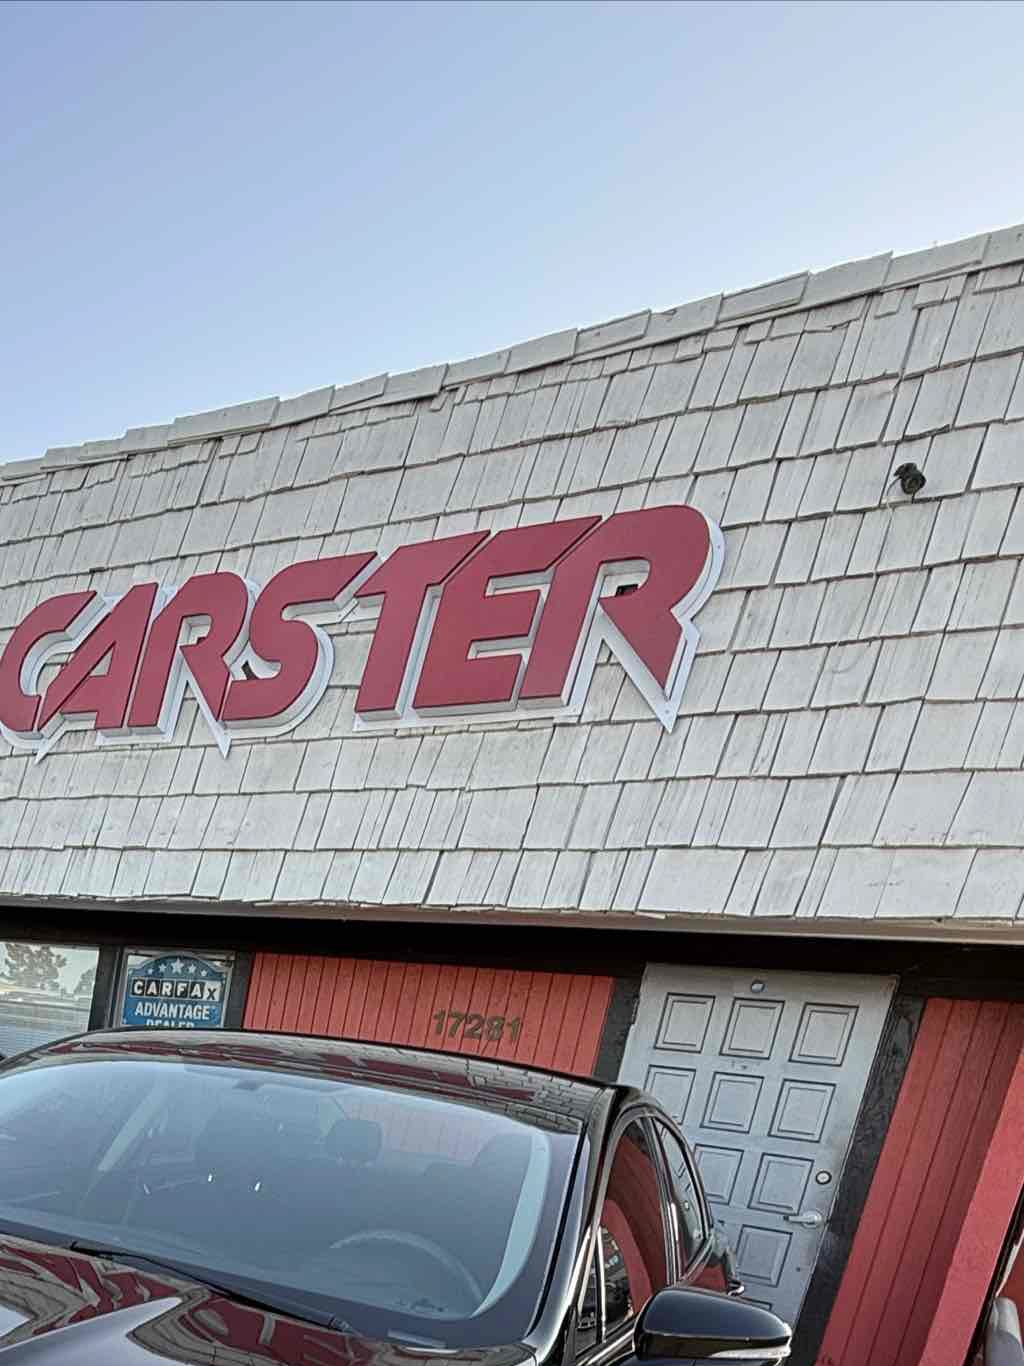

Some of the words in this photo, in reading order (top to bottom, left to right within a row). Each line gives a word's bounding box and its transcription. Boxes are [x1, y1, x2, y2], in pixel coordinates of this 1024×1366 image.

[132, 980, 218, 1001] CARFAX
[135, 1001, 210, 1020] ADVANTAGE
[434, 1009, 520, 1041] 17281
